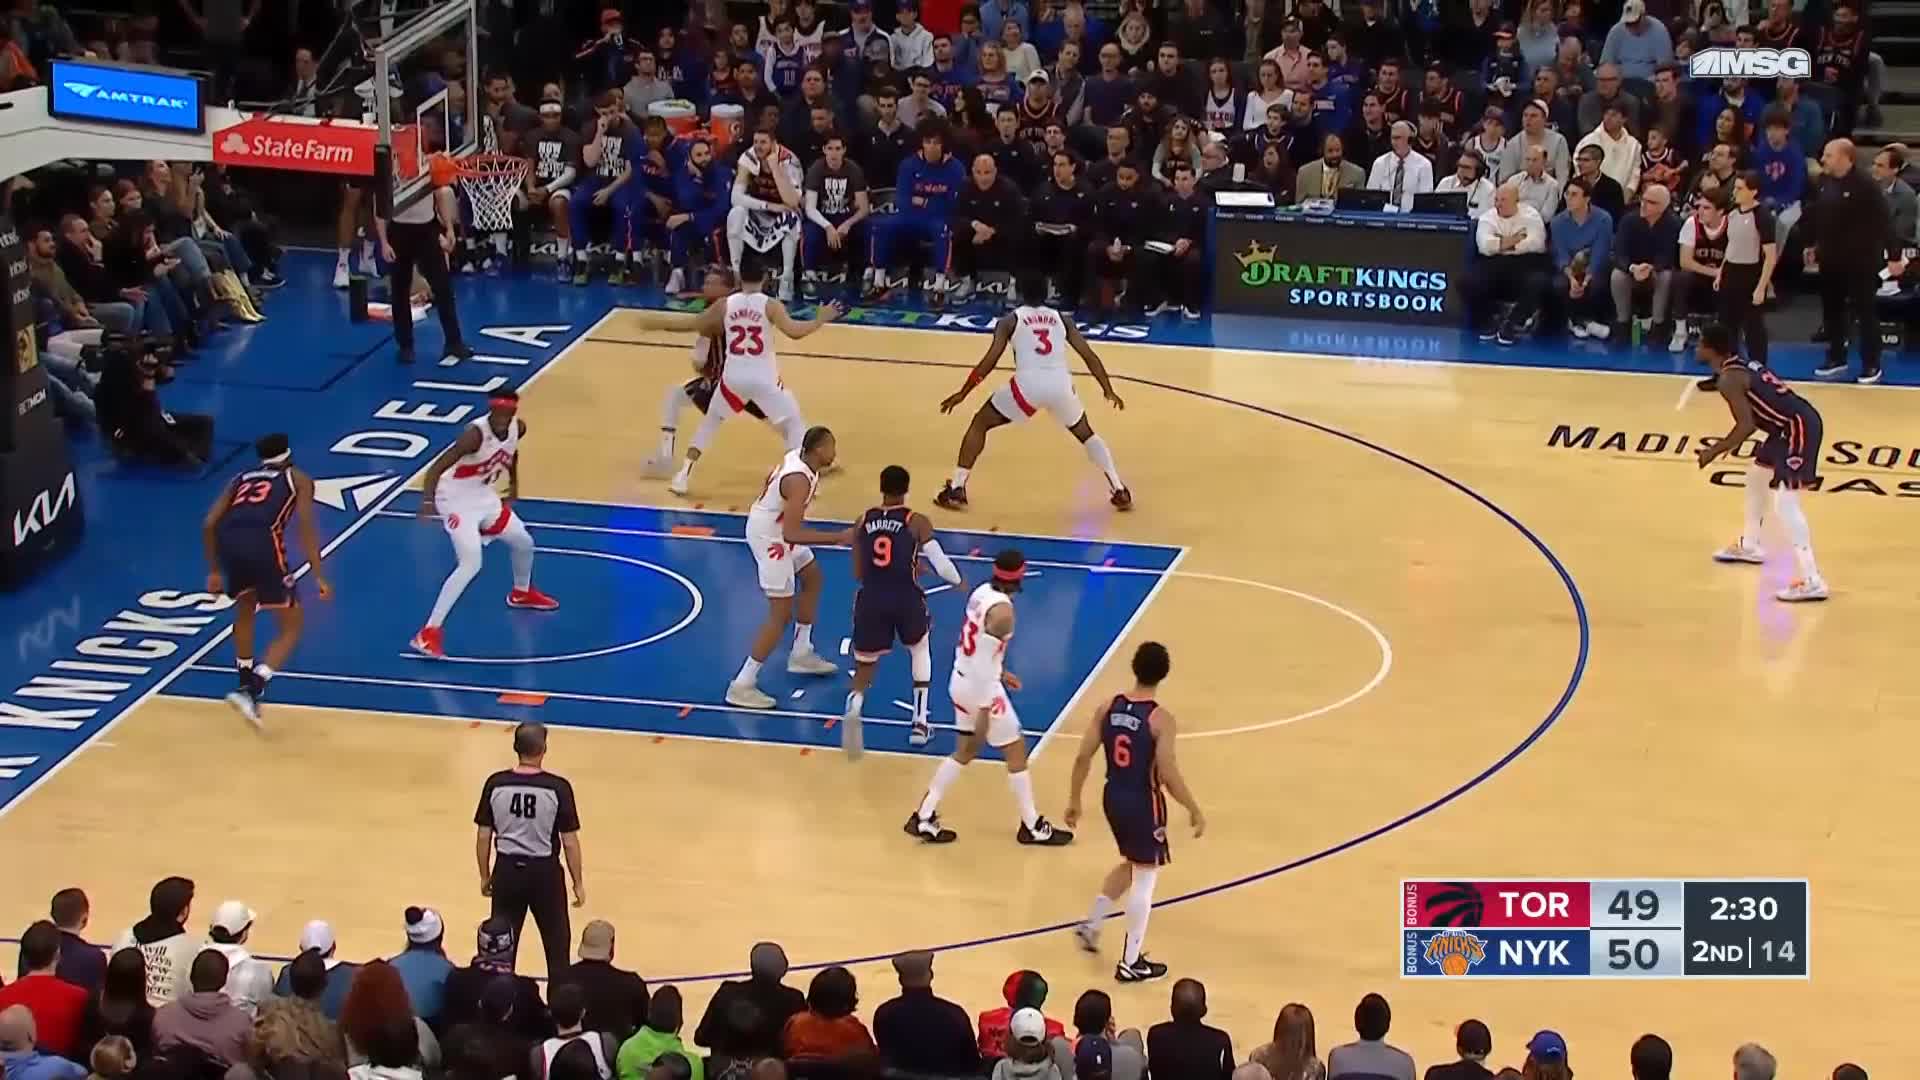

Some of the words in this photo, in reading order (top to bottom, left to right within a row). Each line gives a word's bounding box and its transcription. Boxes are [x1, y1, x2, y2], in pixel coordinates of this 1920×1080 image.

[96, 89, 186, 109] AMTRAK
[1241, 261, 1447, 291] DRAFTKINGS
[1289, 288, 1444, 312] SPORTSBOOK
[729, 325, 764, 355] 23
[1033, 329, 1053, 356] 3
[231, 481, 272, 506] 23
[865, 519, 904, 535] BARRETT
[873, 536, 892, 567] 9
[1114, 734, 1131, 767] 6
[510, 792, 537, 819] 48
